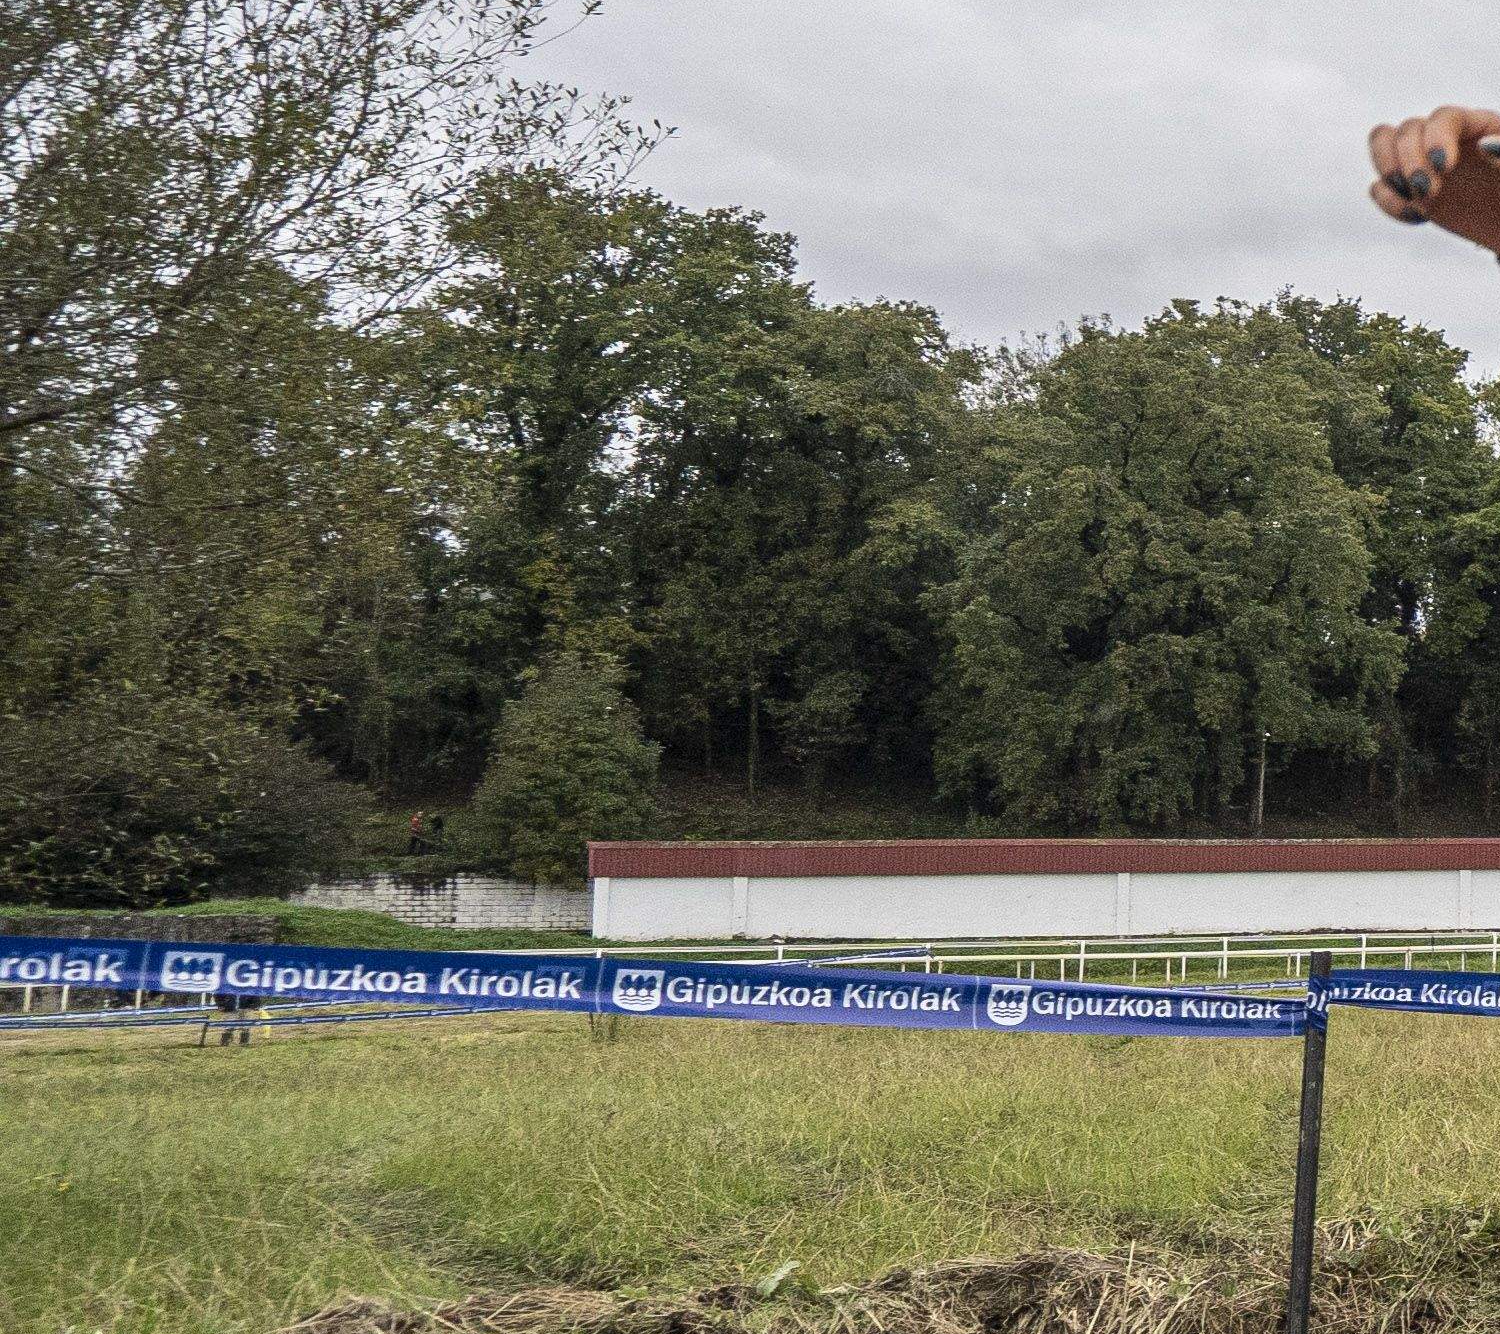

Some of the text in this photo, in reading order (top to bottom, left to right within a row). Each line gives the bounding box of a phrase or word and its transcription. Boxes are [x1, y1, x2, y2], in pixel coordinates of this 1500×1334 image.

[0, 953, 123, 983] rolak
[225, 960, 583, 999] Gipuzkoa Kirolak
[665, 977, 962, 1012] Gipuzkoa Kirolak
[1032, 992, 1172, 1019] Gipuzkoa
